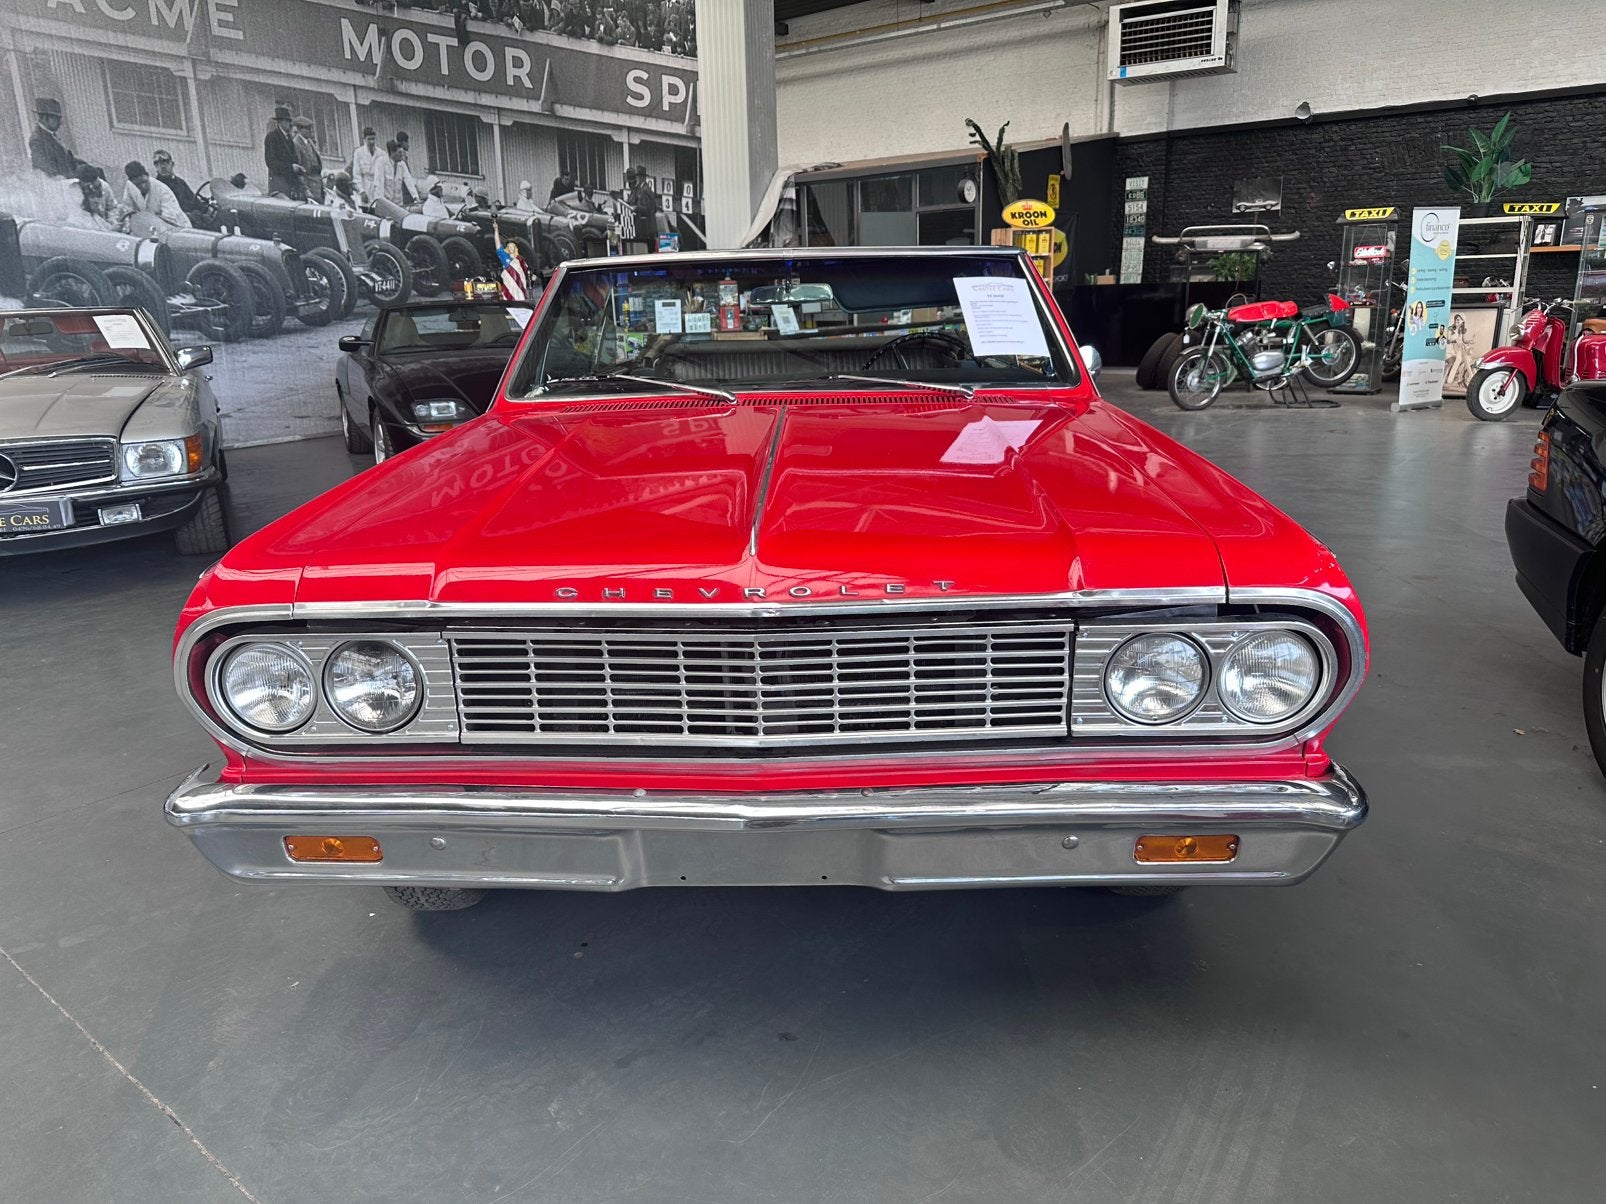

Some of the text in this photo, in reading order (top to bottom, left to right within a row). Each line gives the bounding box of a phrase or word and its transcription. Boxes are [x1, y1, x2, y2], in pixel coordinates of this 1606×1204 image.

[340, 17, 533, 89] MOTOR
[1512, 204, 1548, 212] TAXI
[1010, 210, 1047, 220] KROON
[1353, 209, 1385, 218] TAXI
[1022, 219, 1039, 227] OIL
[10, 514, 49, 526] CARS
[555, 580, 957, 600] CHEVROLET
